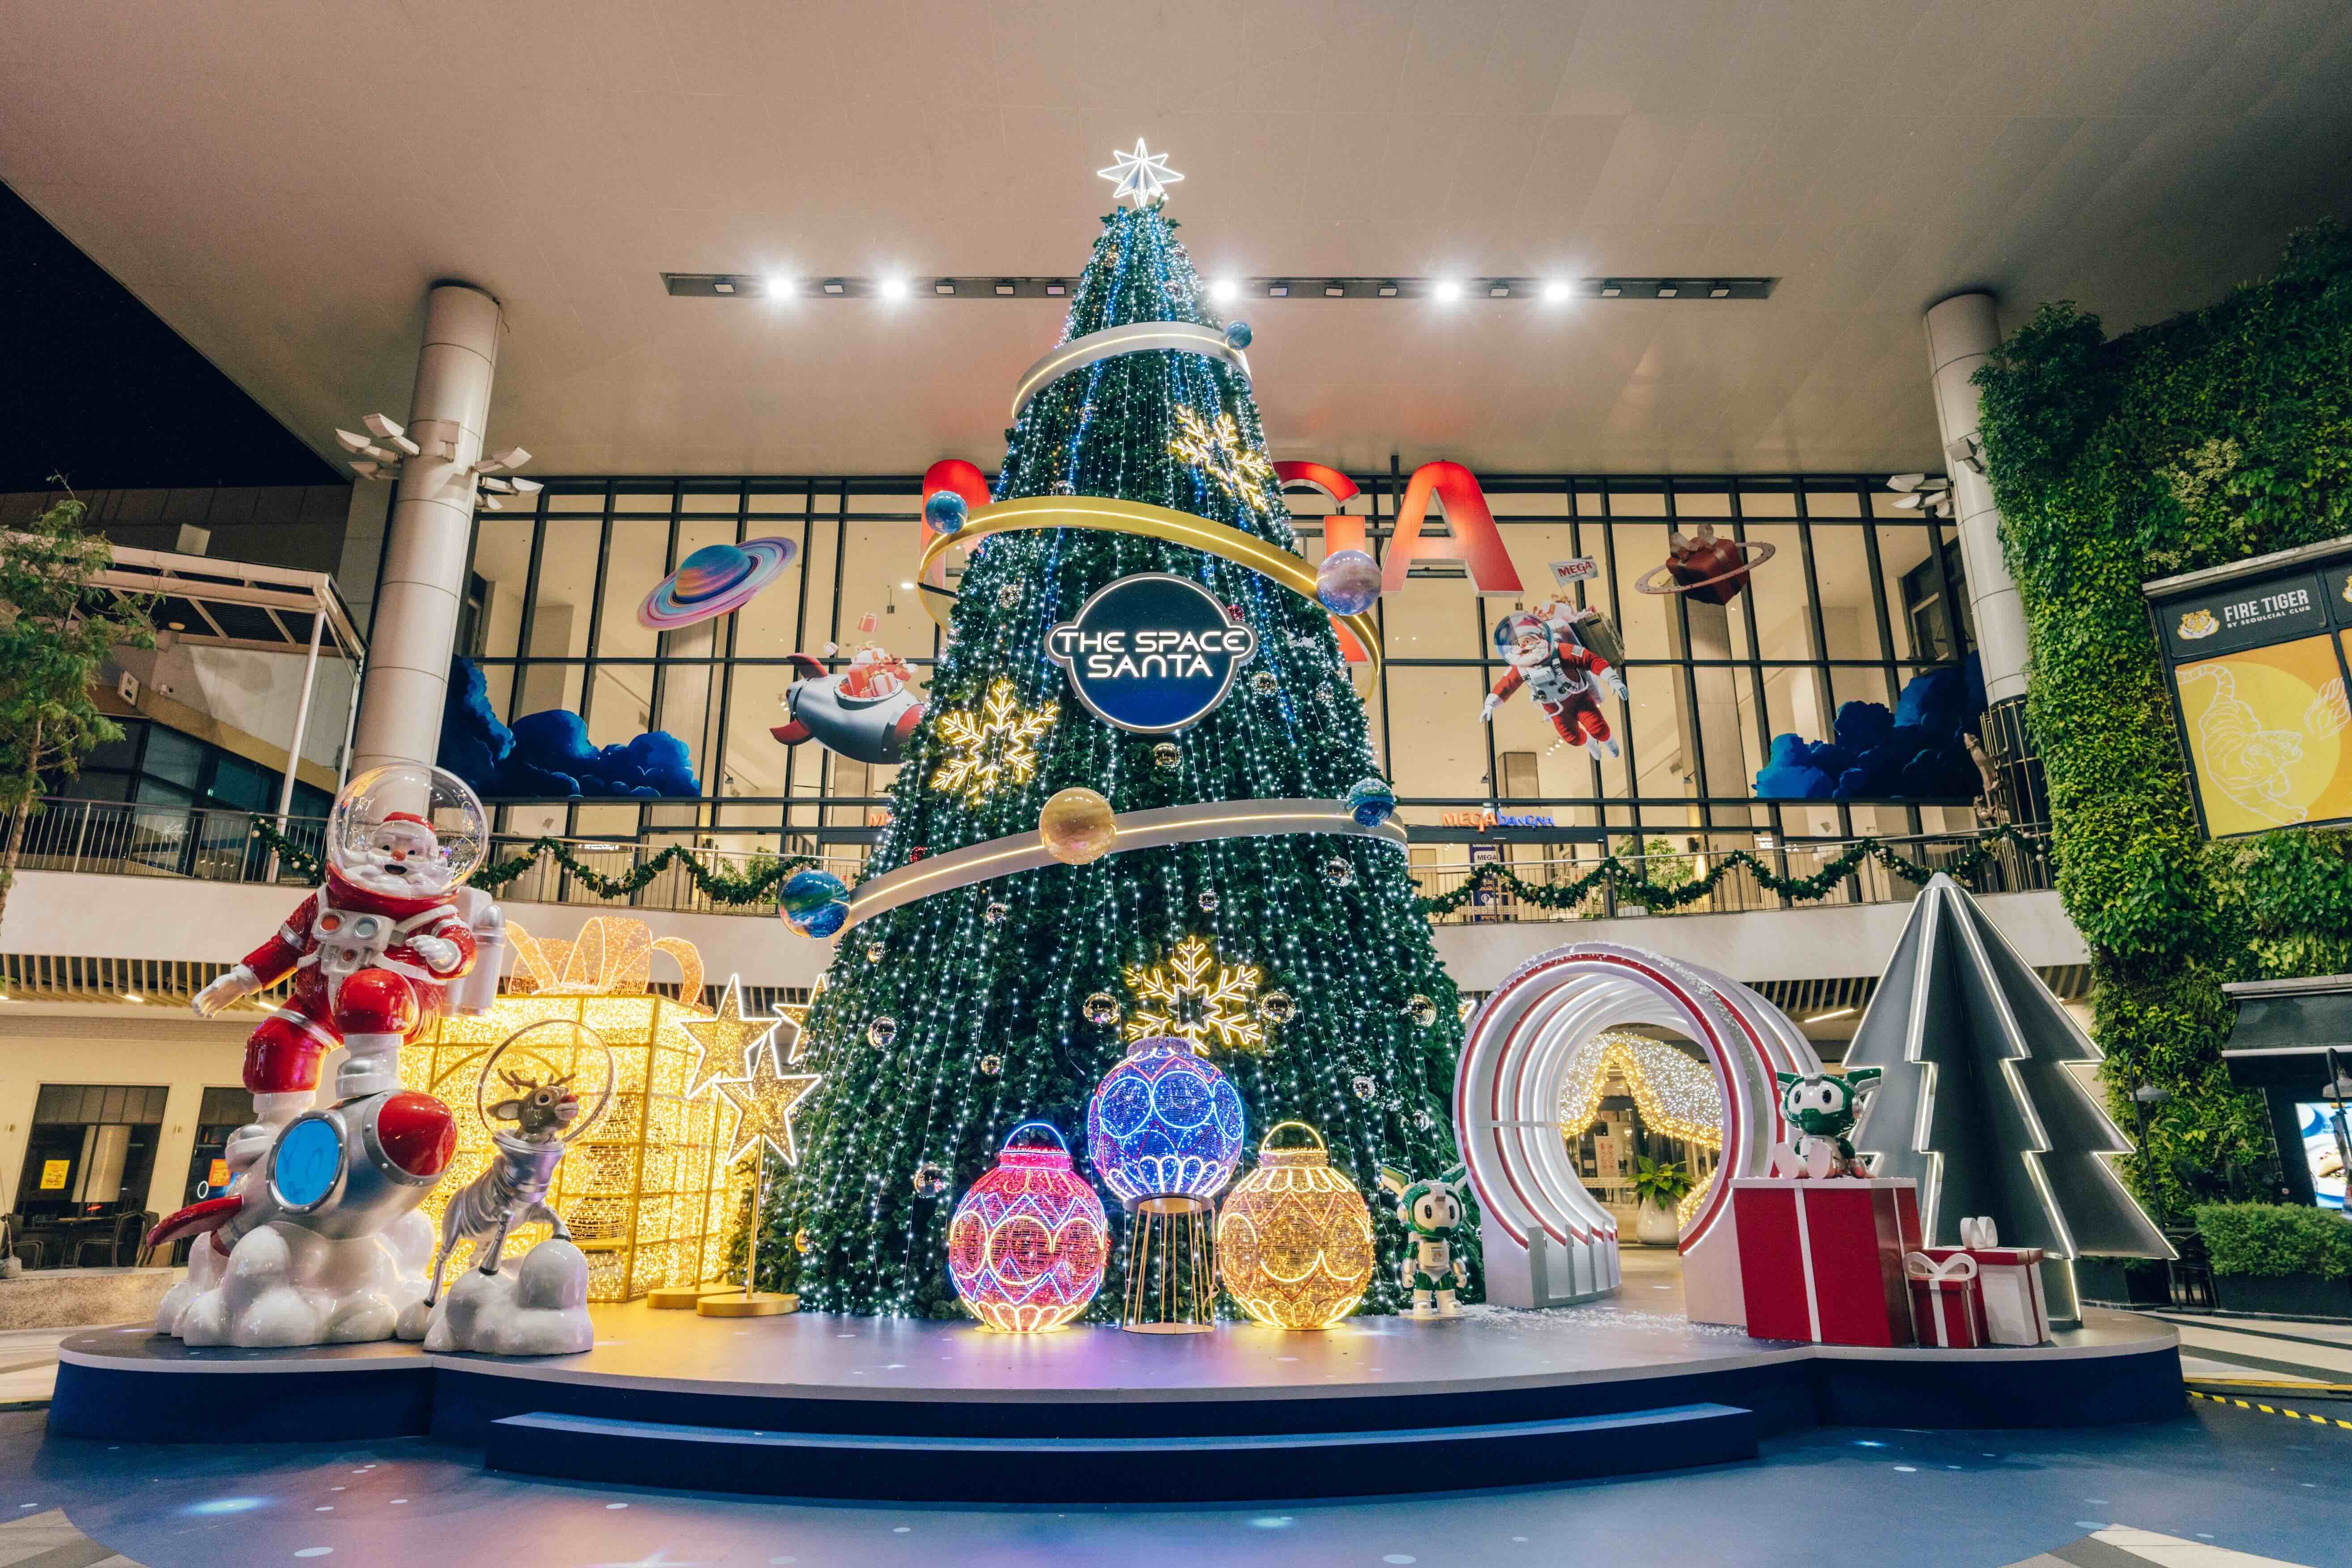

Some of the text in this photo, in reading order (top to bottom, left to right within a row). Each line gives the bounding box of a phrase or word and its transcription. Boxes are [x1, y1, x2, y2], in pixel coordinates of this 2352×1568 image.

[1558, 561, 1593, 576] MEGA
[2224, 589, 2309, 622] FIRE TIGER
[2241, 611, 2286, 626] SEOULCIAL
[2289, 605, 2311, 614] CLUB
[1057, 631, 1245, 652] THE SPACE
[1087, 654, 1213, 678] SANTA
